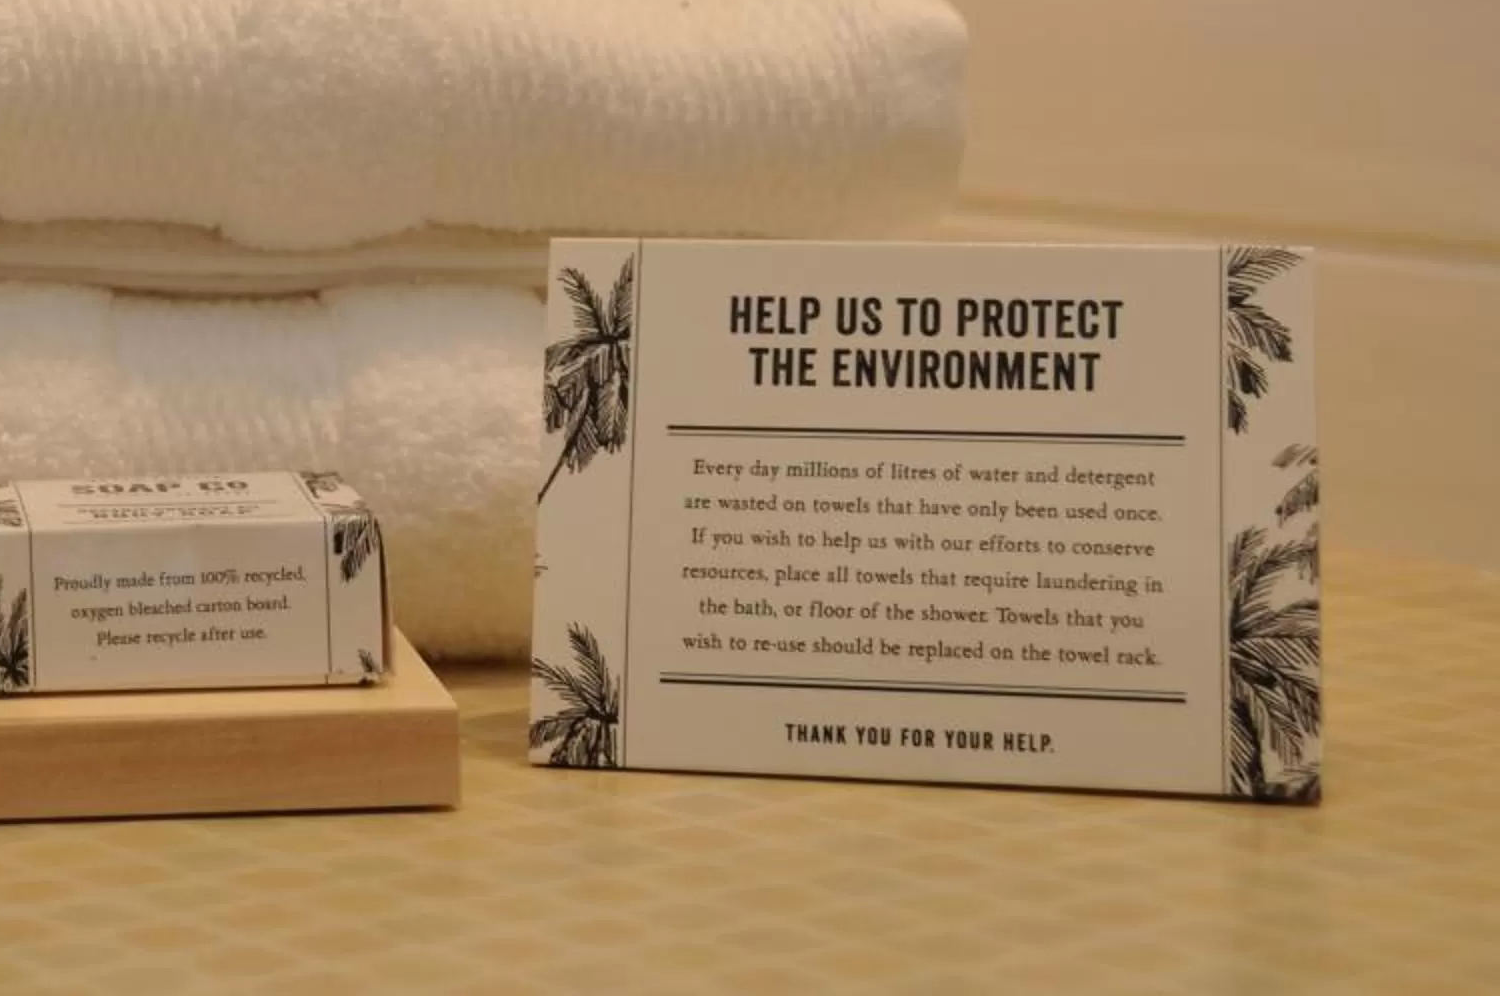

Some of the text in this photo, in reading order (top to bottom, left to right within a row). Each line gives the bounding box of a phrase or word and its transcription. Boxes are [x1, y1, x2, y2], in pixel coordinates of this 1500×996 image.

[729, 295, 1124, 340] HELP US TO PROTECT
[748, 346, 1102, 392] THE ENVIRONMENT
[692, 457, 1155, 492] Every day millions of litres of water and detergent
[683, 493, 1163, 523] are wasted on towels that have only been used once.
[691, 526, 1155, 557] If you wish to help us with our efforts to conserve
[52, 573, 112, 594] Proudly
[115, 570, 156, 589] made
[158, 571, 196, 588] from
[199, 568, 240, 586] 100%
[681, 561, 1164, 598] resources, place all towels that require laundering in
[70, 605, 124, 623] oxygen
[127, 596, 194, 618] bleached
[194, 598, 243, 615] carton
[698, 595, 730, 616] the
[732, 596, 778, 619] bath,
[782, 603, 803, 618] or
[807, 599, 856, 620] floor
[858, 600, 881, 620] of
[884, 602, 915, 621] the
[993, 605, 1060, 626] Towels
[1065, 607, 1104, 629] that
[1109, 614, 1144, 634] you
[95, 628, 142, 649] Please
[145, 625, 197, 649] recycle
[199, 624, 236, 643] after
[681, 631, 723, 651] wish
[728, 635, 748, 652] to
[751, 638, 807, 653] re-use
[811, 635, 875, 656] should
[878, 636, 902, 657] be
[907, 639, 985, 664] replaced
[988, 645, 1015, 661] on
[1020, 642, 1052, 662] the
[1057, 644, 1110, 666] towel
[784, 722, 1054, 753] THANK YOU FOR YOUR HELP.
